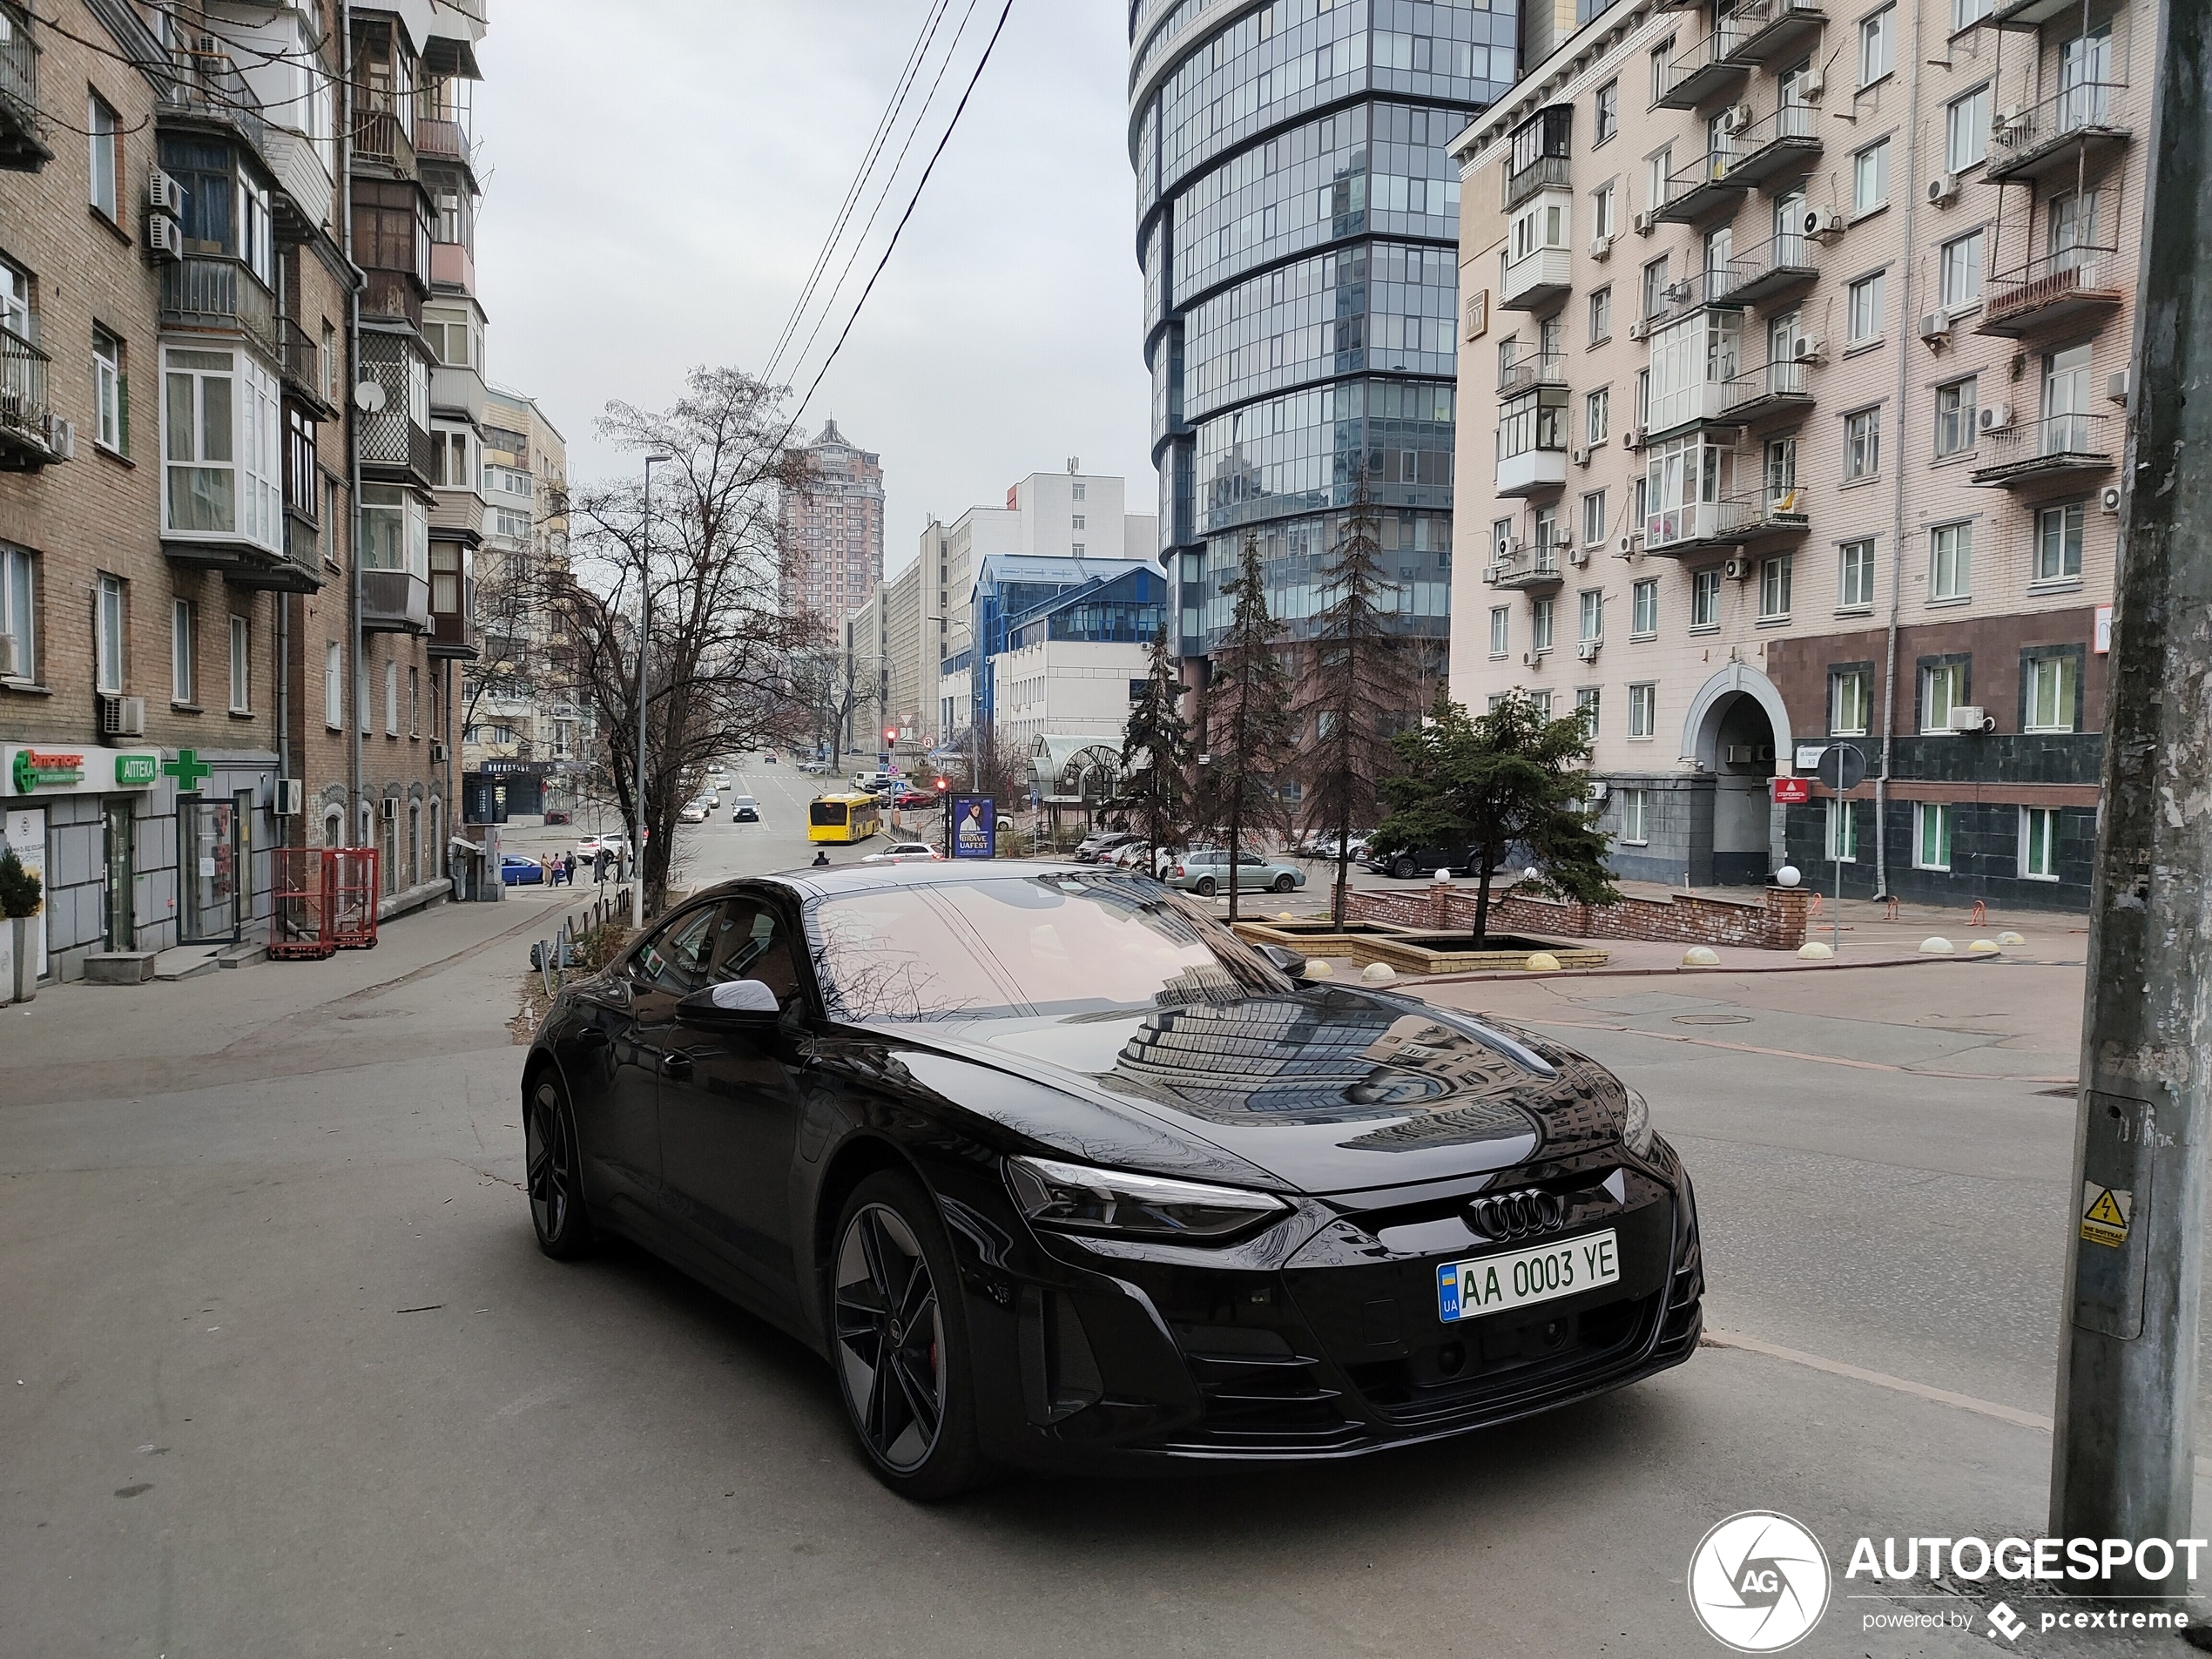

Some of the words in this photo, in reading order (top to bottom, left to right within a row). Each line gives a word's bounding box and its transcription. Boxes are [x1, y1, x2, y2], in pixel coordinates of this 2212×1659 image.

[124, 760, 154, 778] АПТЕКА
[1461, 1265, 1502, 1309] AA
[1514, 1250, 1574, 1297] 0003
[1583, 1239, 1615, 1280] YE
[1444, 1299, 1458, 1312] UA
